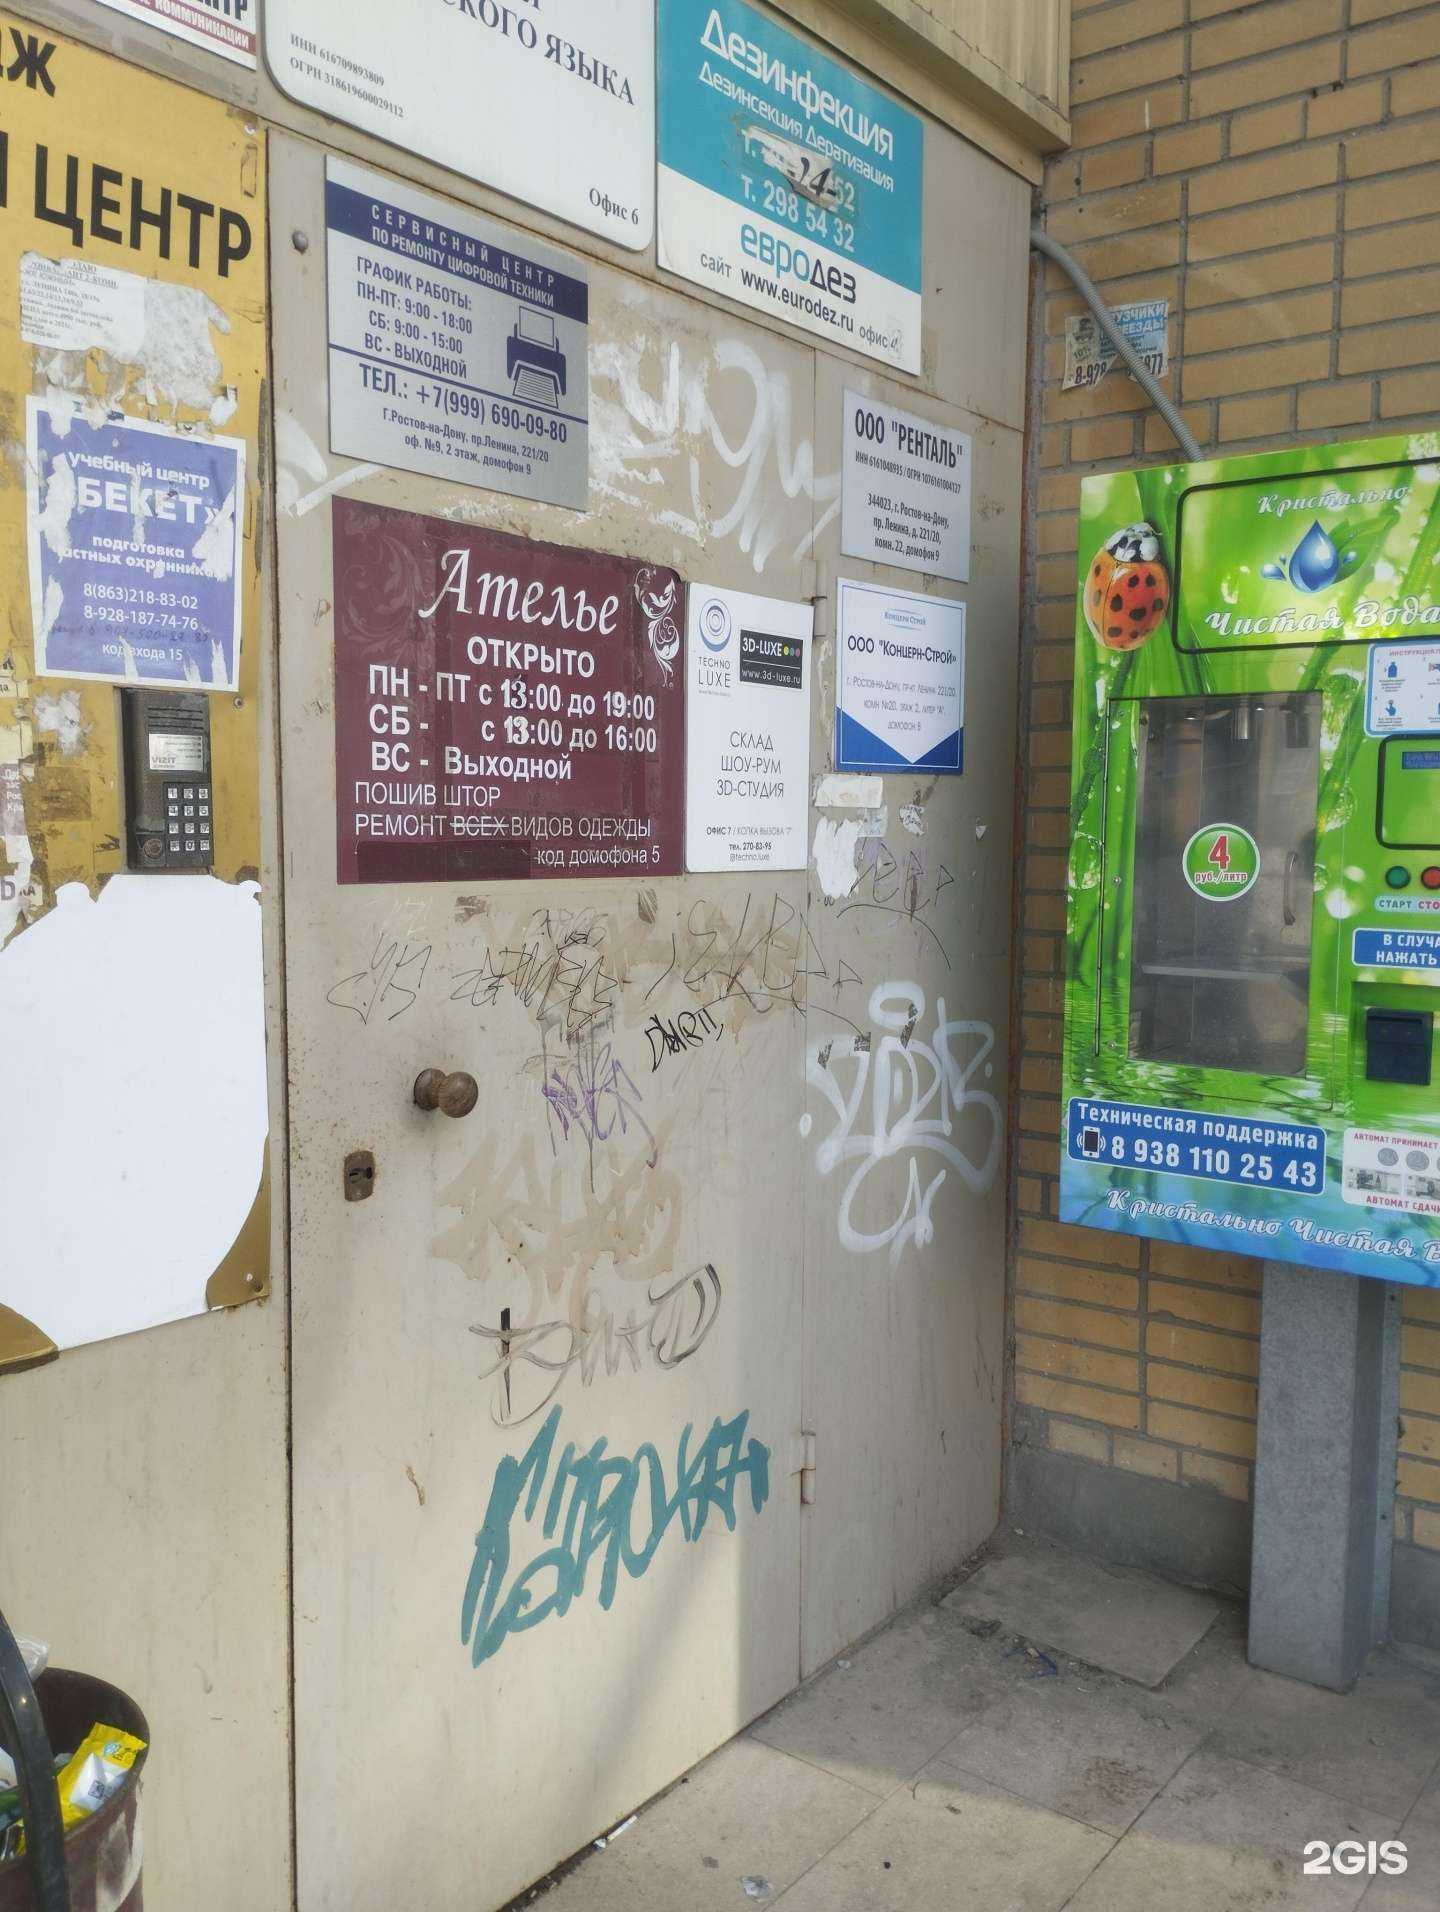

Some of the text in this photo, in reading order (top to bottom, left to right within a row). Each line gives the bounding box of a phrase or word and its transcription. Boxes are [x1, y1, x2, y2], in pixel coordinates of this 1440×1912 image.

[290, 33, 317, 56] ИНН
[442, 0, 635, 106] КОГО ЯЗЫКА
[0, 25, 57, 97] Ж
[290, 56, 322, 80] ОГРН
[35, 143, 251, 278] ЦЕНТР
[589, 188, 640, 226] Офис 6
[764, 180, 799, 223] 298
[805, 207, 828, 240] 54
[833, 222, 856, 253] 32
[371, 205, 555, 288] СЕРВИСНЫЙ ЦЕНТР
[357, 256, 473, 311] ГРАФИК РАБОТЫ:
[371, 226, 555, 309] ПО РЕМОНТУ ЦИФРОВОЙ ТЕХНИКИ
[357, 280, 473, 336] ПН-ПТ: 9:00 18:00
[700, 252, 732, 280] сайт
[740, 268, 854, 333] www.eurodez.ru
[859, 324, 888, 352] офис
[368, 309, 463, 355] СБ: 9:00 15:00
[364, 332, 467, 379] ВС ВЫХОДНОЙ
[358, 362, 568, 444] ТЕЛ.: +7(999) 690-09-80
[521, 442, 549, 463] 221/20
[854, 408, 963, 469] ООО "РЕНТАЛЬ"
[68, 450, 210, 491] учебный центр
[404, 434, 421, 451] оф.
[446, 441, 451, 455] 2
[482, 449, 524, 474] домофон
[526, 462, 532, 476] 9
[855, 450, 869, 463] ИНН
[906, 468, 921, 481] ОГРН
[1258, 486, 1410, 518] Кристально
[873, 516, 884, 530] пр.
[92, 535, 185, 559] подготовка
[874, 536, 895, 552] комн.
[905, 543, 935, 561] домофон
[83, 583, 199, 610] 8(863)218-83-02
[418, 548, 620, 636] Ателье
[83, 605, 200, 631] 8-928-187-74-76
[1204, 596, 1440, 637] Чистая Вода
[168, 647, 183, 663] 15
[466, 635, 595, 679] ОТКРЫТО
[741, 636, 782, 657] 3D-LUXE
[847, 635, 875, 654] ООО
[697, 656, 731, 670] TECHNO
[697, 668, 731, 689] LUXE
[741, 668, 801, 685] www.3d-luxe.ru
[369, 663, 409, 698] ПН
[436, 671, 471, 703] ПТ
[478, 681, 493, 706] с
[567, 692, 597, 719] до
[602, 690, 656, 721] 19:00
[368, 703, 410, 736] СБ
[481, 719, 496, 742] с
[568, 728, 597, 752] до
[603, 724, 657, 753] 16:00
[729, 730, 774, 752] СКЛАД
[370, 741, 411, 773] ВС
[444, 745, 572, 783] Выходной
[720, 754, 781, 775] ШОУ-РУМ
[355, 781, 501, 807] ПОШИВ ШТОР
[716, 778, 785, 800] 3D-СТУДИЯ
[355, 813, 448, 837] РЕМОНТ
[511, 816, 574, 840] ВИДОВ
[577, 817, 652, 841] ОДЕЖДЫ
[538, 846, 661, 870] код домофона 5
[1208, 833, 1231, 871] 4
[1379, 899, 1412, 909] СТАРТ
[1383, 934, 1393, 946] В
[1376, 950, 1438, 966] НАЖАТЬ
[1077, 1102, 1319, 1152] Техническая поддержка
[1354, 1132, 1390, 1142] АВТОМАТ
[1111, 1135, 1318, 1188] 8 938 110 25 43
[1366, 1195, 1410, 1209] АВТОМАТ
[1105, 1190, 1284, 1237] Кристально
[1288, 1218, 1418, 1260] Чистая
